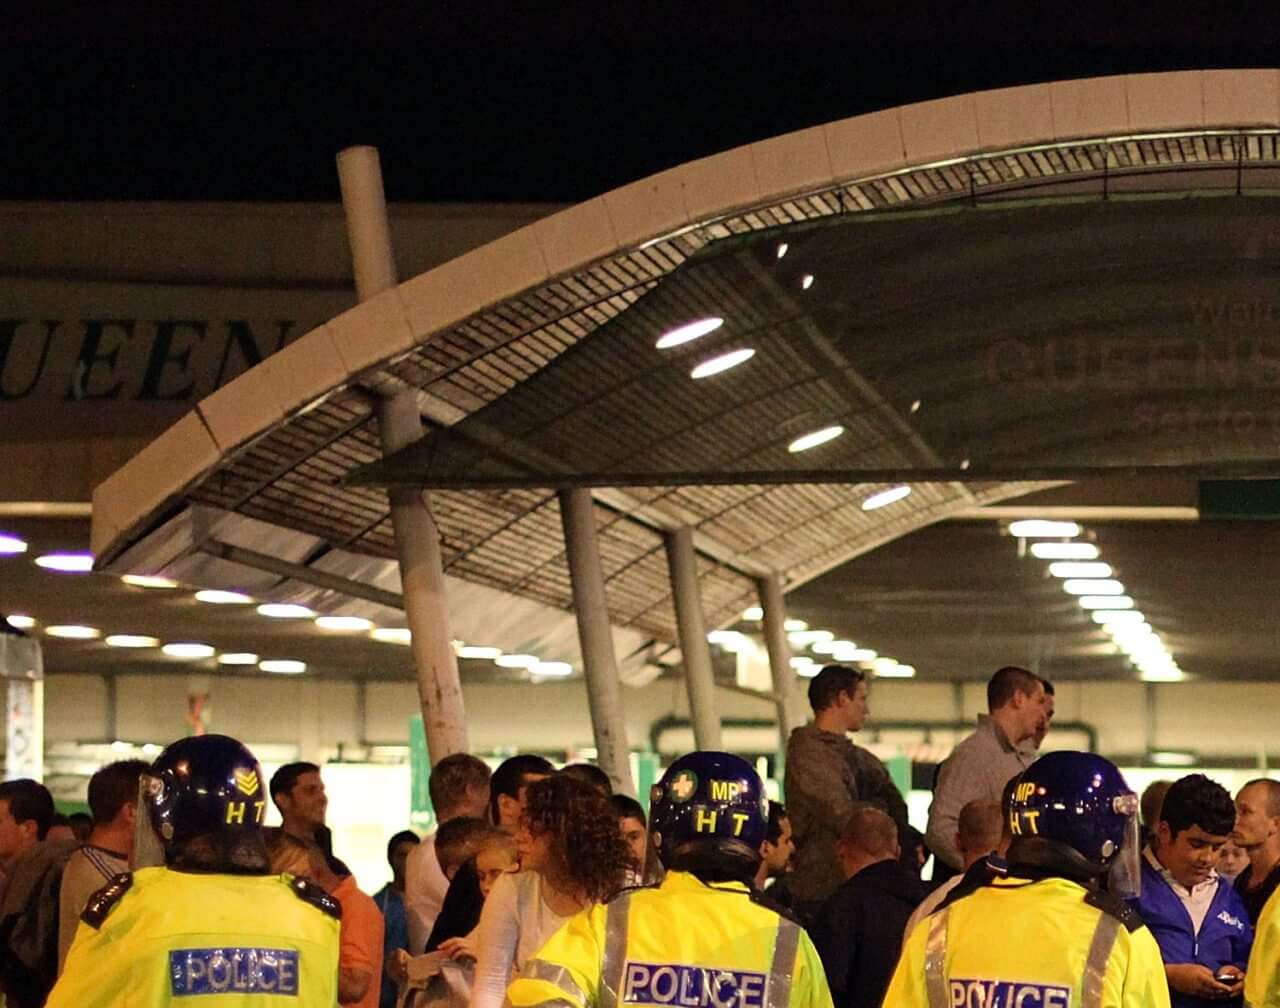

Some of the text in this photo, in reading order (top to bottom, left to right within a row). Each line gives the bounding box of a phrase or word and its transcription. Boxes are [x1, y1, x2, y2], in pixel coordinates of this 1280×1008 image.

[0, 319, 295, 400] UEEN
[711, 780, 741, 801] MP
[1015, 782, 1036, 802] MP
[185, 954, 295, 991] POLICE
